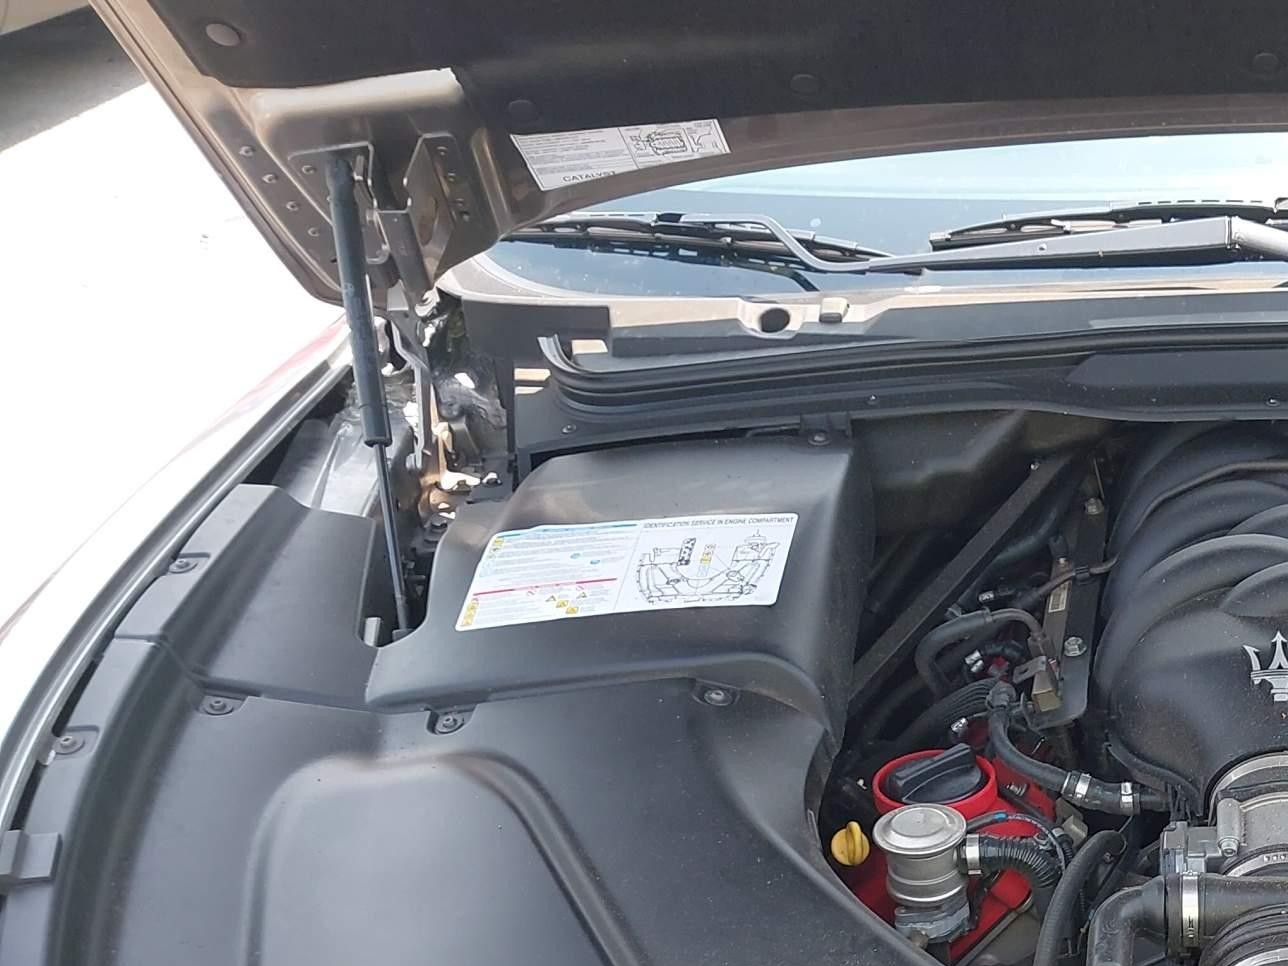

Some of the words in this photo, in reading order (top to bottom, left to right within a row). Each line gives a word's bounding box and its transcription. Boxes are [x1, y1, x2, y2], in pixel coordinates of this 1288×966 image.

[643, 520, 689, 529] IDENTIFICATION
[691, 519, 716, 527] SERVICE
[725, 518, 746, 526] ENGINE
[748, 516, 795, 525] COMPARTMENT
